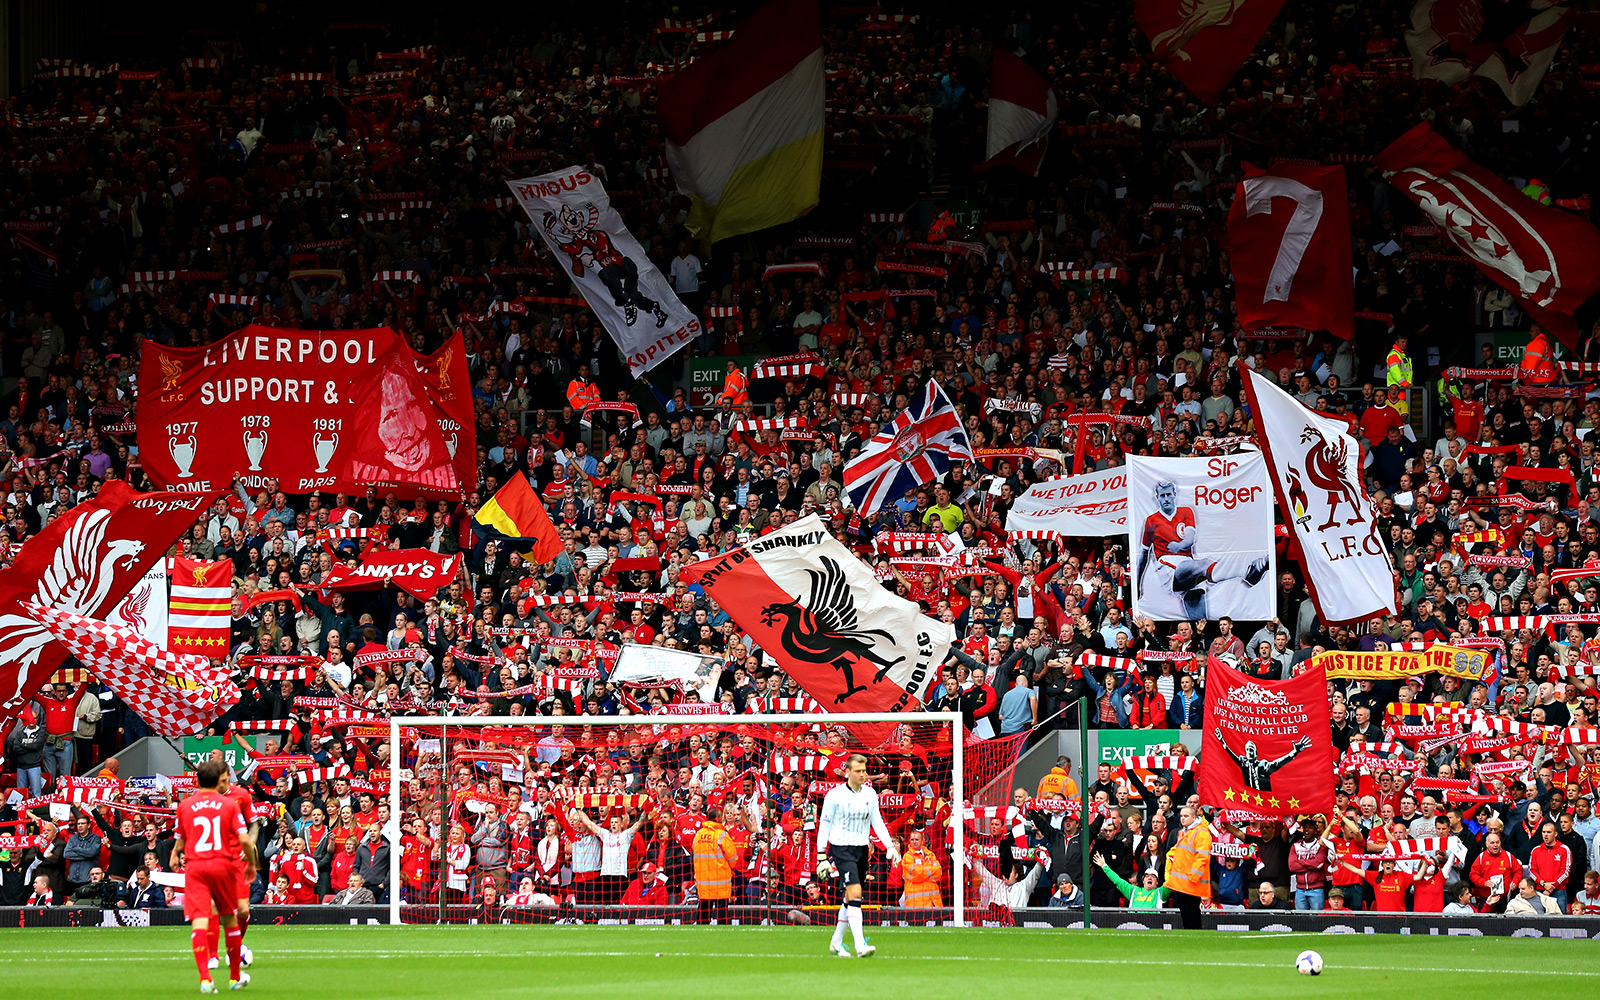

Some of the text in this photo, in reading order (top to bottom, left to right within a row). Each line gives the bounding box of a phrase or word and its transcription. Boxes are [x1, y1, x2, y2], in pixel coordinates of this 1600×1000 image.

[1243, 175, 1323, 304] 7
[886, 262, 935, 273] LIVERPOOL
[203, 336, 377, 368] LIVERPOOL
[629, 319, 701, 372] KOPITES
[766, 353, 811, 363] LIVERPOOL
[693, 370, 720, 382] EXIT
[200, 377, 339, 405] SUPPORT &
[161, 394, 186, 402] L.F.C.
[999, 399, 1031, 410] SHNKLY
[165, 421, 199, 435] 1977
[240, 415, 271, 428] 1978
[313, 418, 342, 431] 1981
[973, 449, 1011, 457] LIVERPOOL
[1208, 458, 1238, 477] Sir
[167, 480, 212, 492] ROME
[298, 476, 337, 490] PARIS
[660, 485, 693, 493] LIVERPOOL
[1031, 489, 1057, 501] WE
[1060, 481, 1097, 496] TOLD
[1195, 485, 1262, 509] Roger
[729, 531, 826, 566] OF SHANKLY
[940, 557, 951, 565] FC
[349, 560, 436, 580] ANKLY'S
[359, 650, 413, 664] LIVERPOOL FC
[1390, 656, 1419, 672] FOR
[1424, 651, 1452, 668] THE
[1454, 652, 1484, 674] 96
[407, 701, 453, 709] LIVERPOOL
[669, 707, 706, 715] SHANKLY
[1218, 698, 1304, 715] LIVERPOOL FC IS NOT
[1214, 706, 1227, 716] JUST
[1234, 714, 1279, 725] FOOTBALL
[1281, 715, 1308, 723] CLUB
[1220, 719, 1227, 727] IT
[1227, 721, 1234, 729] IS
[1241, 726, 1260, 735] WAY
[1277, 726, 1299, 734] LIFE
[1398, 723, 1450, 733] LIVERPOOL FC
[1472, 739, 1510, 749] LIVERPOOL
[1102, 747, 1136, 760] EXIT
[1351, 755, 1406, 767] LIVERPOOL
[1480, 763, 1510, 771] LIVERPOOL
[378, 783, 385, 792] FC
[191, 800, 223, 812] LUCAS
[1035, 799, 1082, 807] LIVERPOOL
[193, 815, 222, 853] 21
